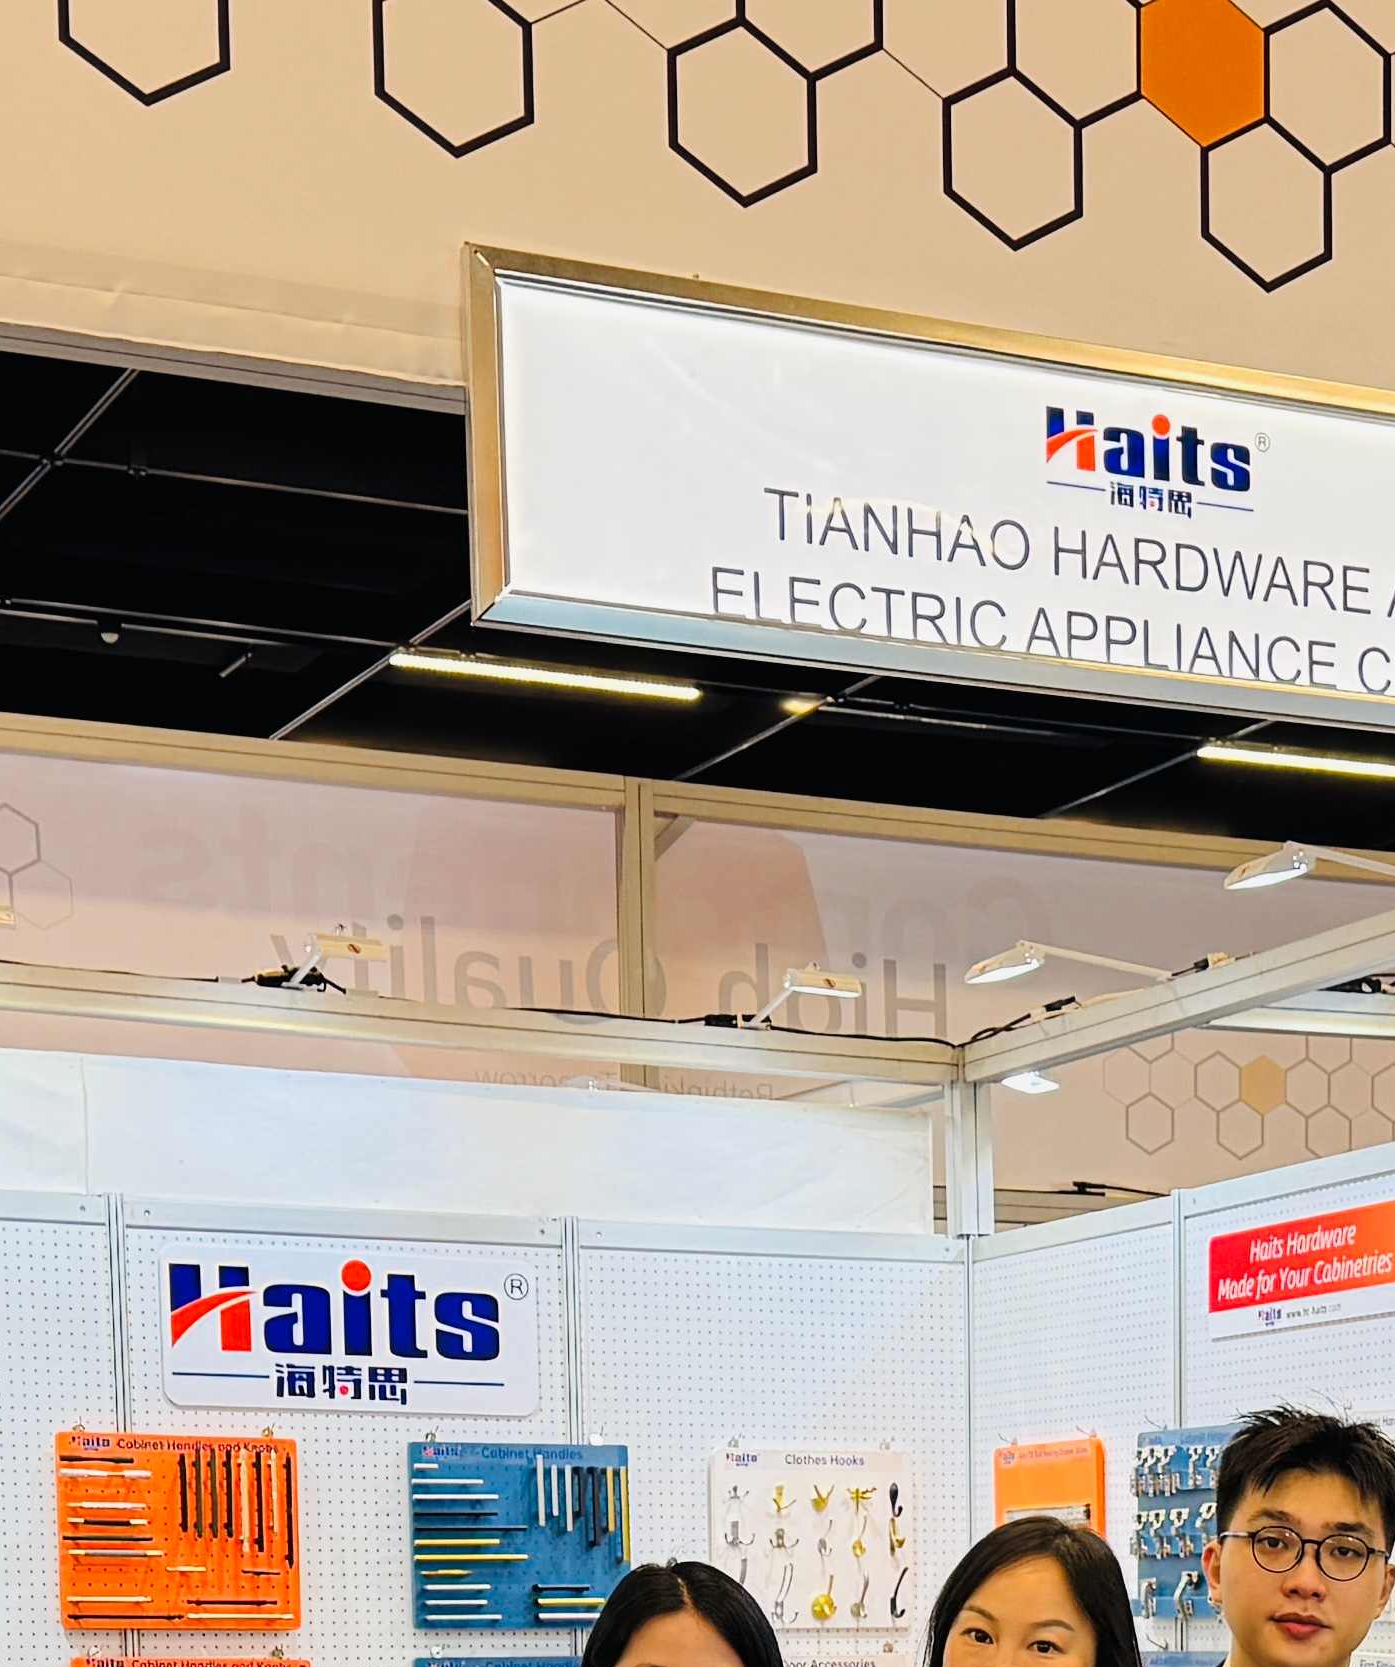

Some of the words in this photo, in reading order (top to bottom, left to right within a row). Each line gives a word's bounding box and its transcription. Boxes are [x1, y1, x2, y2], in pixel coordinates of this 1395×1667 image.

[1045, 405, 1253, 494] Haits
[1108, 480, 1193, 520] 海特思
[763, 487, 1032, 572] TIANHAO
[1052, 523, 1374, 619] HARDWARE
[711, 566, 1007, 652] ELECTRIC
[1028, 606, 1338, 694] APPLIANCE
[1250, 1236, 1284, 1264] Haits
[1286, 1225, 1356, 1256] Hardware
[1217, 1274, 1254, 1301] Made
[1256, 1269, 1277, 1300] for
[1279, 1265, 1310, 1291] Your
[1313, 1251, 1393, 1284] Cabinetries
[168, 1259, 500, 1361] Haits
[275, 1362, 408, 1405] 海特思
[117, 1438, 163, 1450] Cabinet
[481, 1447, 530, 1460] Cabinet
[784, 1453, 827, 1466] Clothes
[829, 1454, 865, 1467] Hooks
